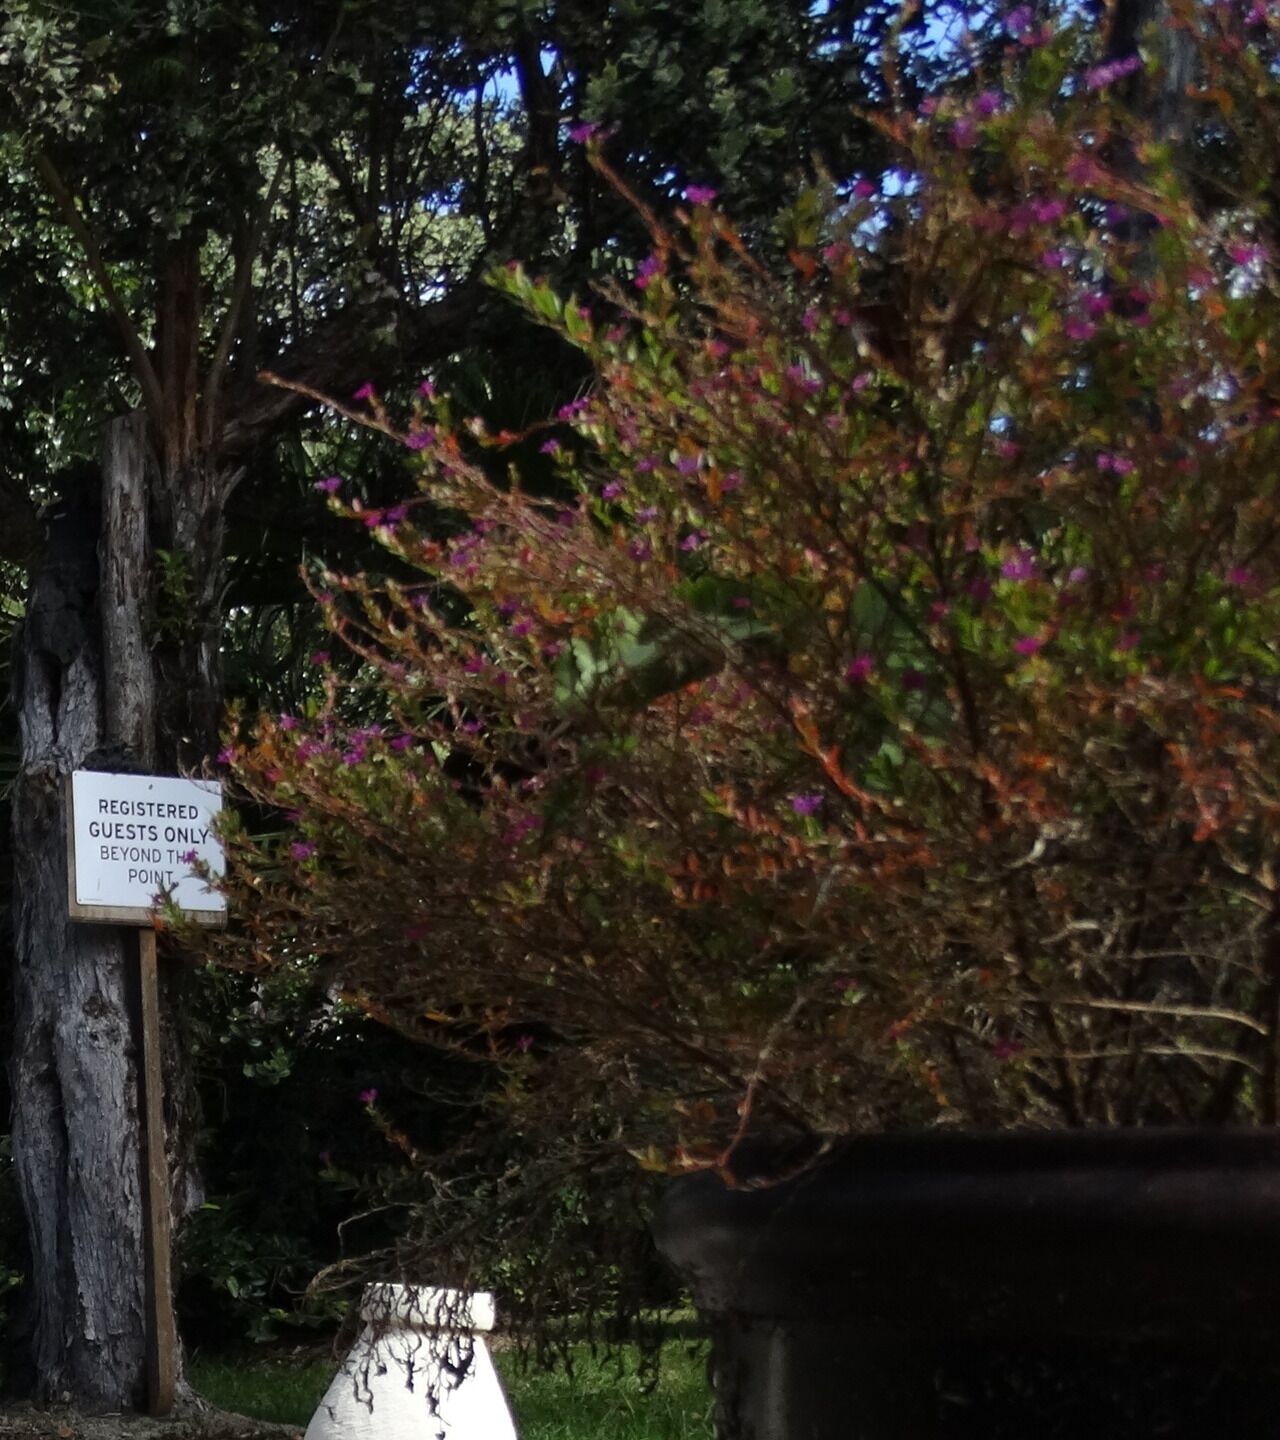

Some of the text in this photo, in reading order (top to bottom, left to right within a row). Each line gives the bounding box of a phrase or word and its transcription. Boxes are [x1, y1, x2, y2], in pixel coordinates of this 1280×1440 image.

[98, 799, 199, 820] REGISTERED
[89, 821, 209, 845] GUESTS ONLY
[100, 845, 198, 864] BEYOND TH
[128, 868, 174, 885] POINT
